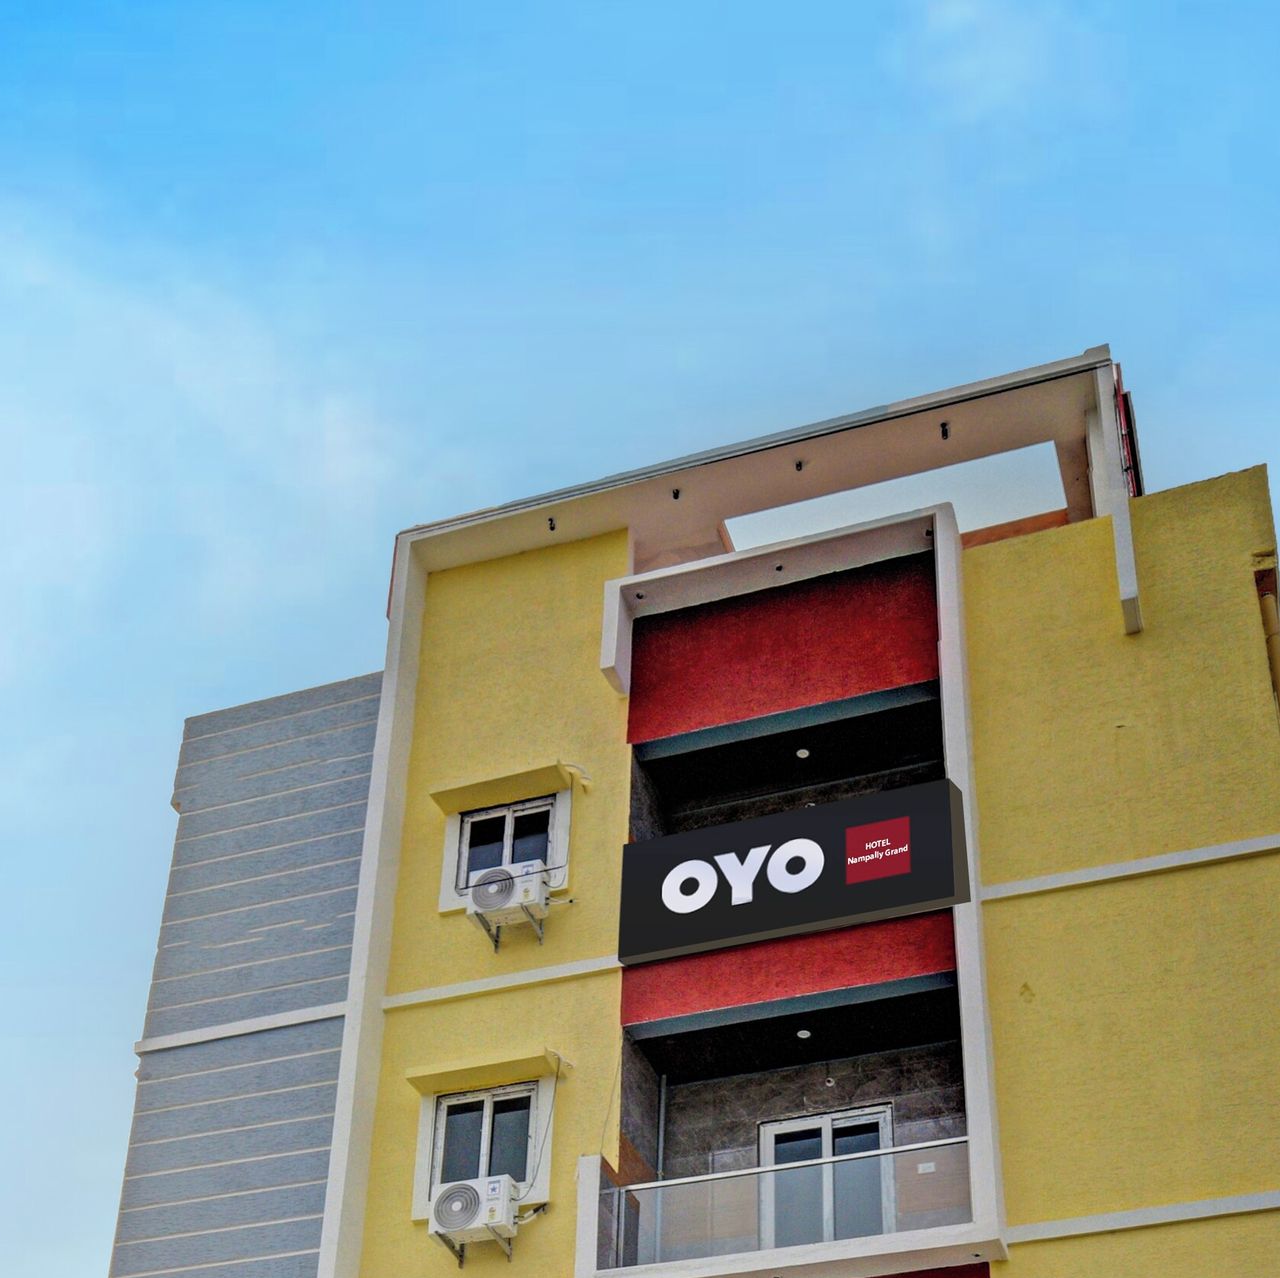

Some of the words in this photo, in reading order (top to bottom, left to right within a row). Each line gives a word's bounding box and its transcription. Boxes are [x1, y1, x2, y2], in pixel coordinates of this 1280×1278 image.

[847, 849, 884, 865] Nampally
[884, 844, 909, 859] Grand
[865, 838, 891, 851] HOTEL
[661, 838, 825, 914] OYO
